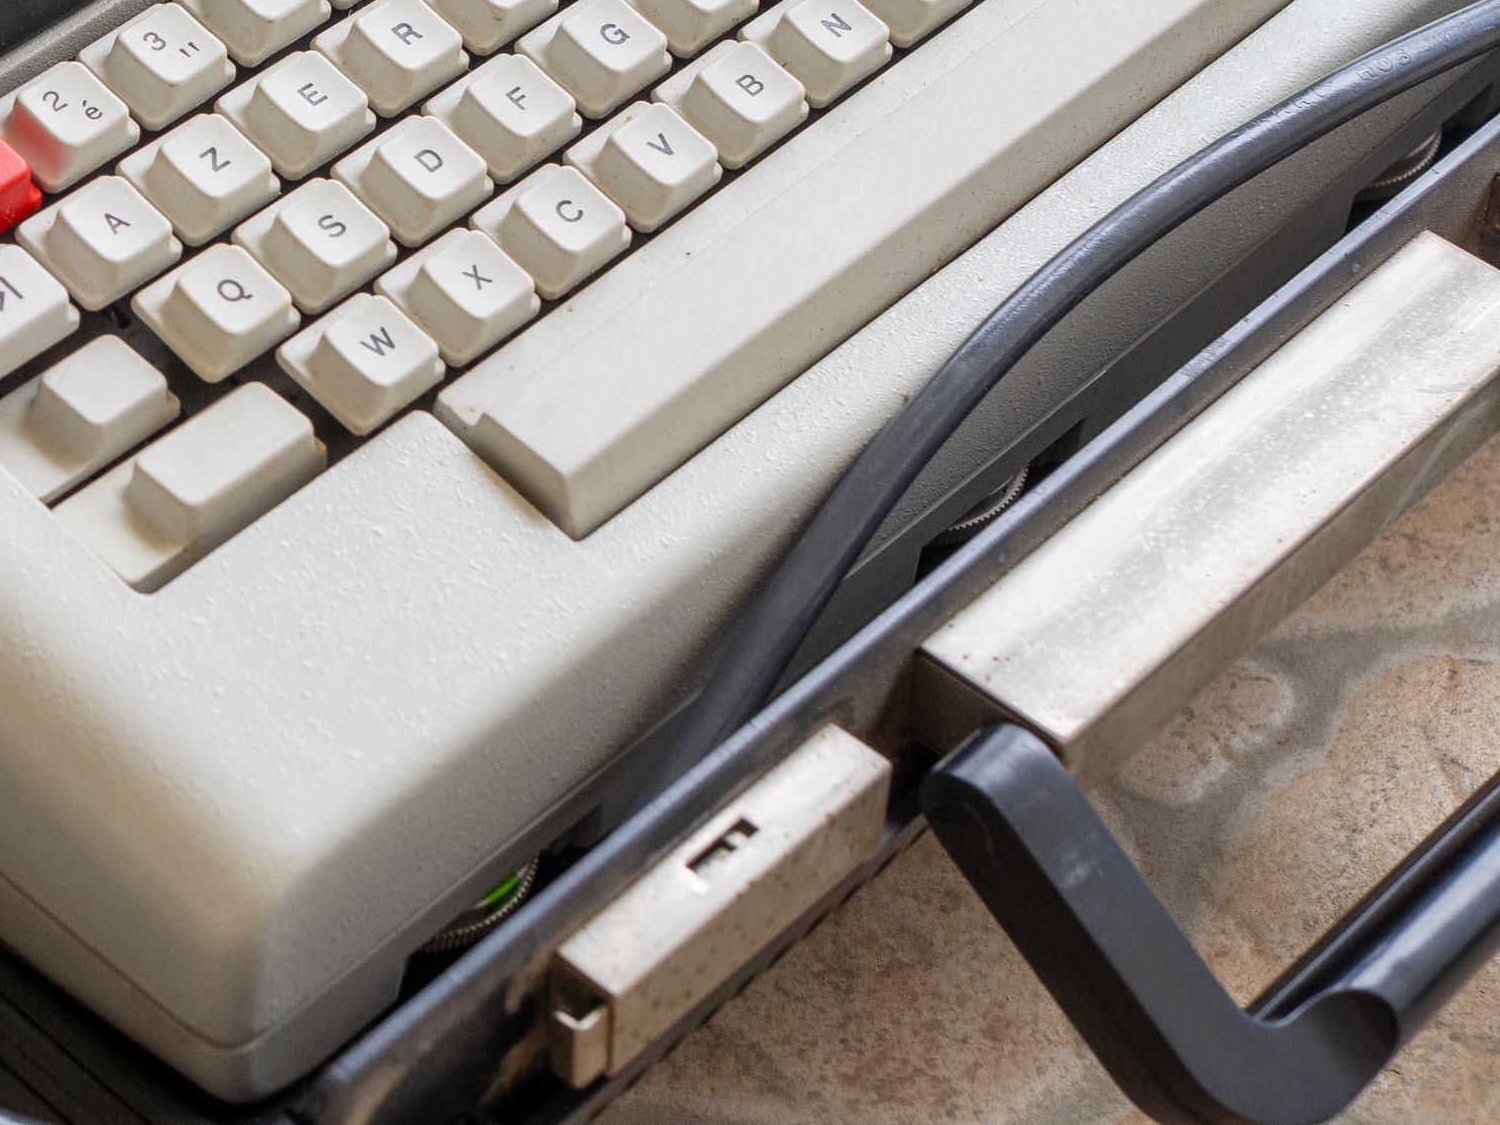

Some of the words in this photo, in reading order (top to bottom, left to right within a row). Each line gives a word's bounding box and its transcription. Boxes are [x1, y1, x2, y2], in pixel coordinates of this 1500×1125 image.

[391, 22, 424, 46] R
[600, 24, 631, 46] G
[820, 12, 852, 38] N
[142, 32, 167, 51] 3
[297, 82, 329, 107] E
[735, 73, 765, 97] B
[42, 90, 69, 113] 2
[505, 86, 528, 111] F
[647, 132, 675, 158] V
[199, 146, 232, 172] Z
[414, 148, 445, 173] D
[555, 199, 584, 223] C
[104, 212, 131, 235] A
[318, 215, 347, 238] S
[461, 265, 493, 290] X
[217, 279, 253, 303] Q
[360, 327, 396, 357] W
